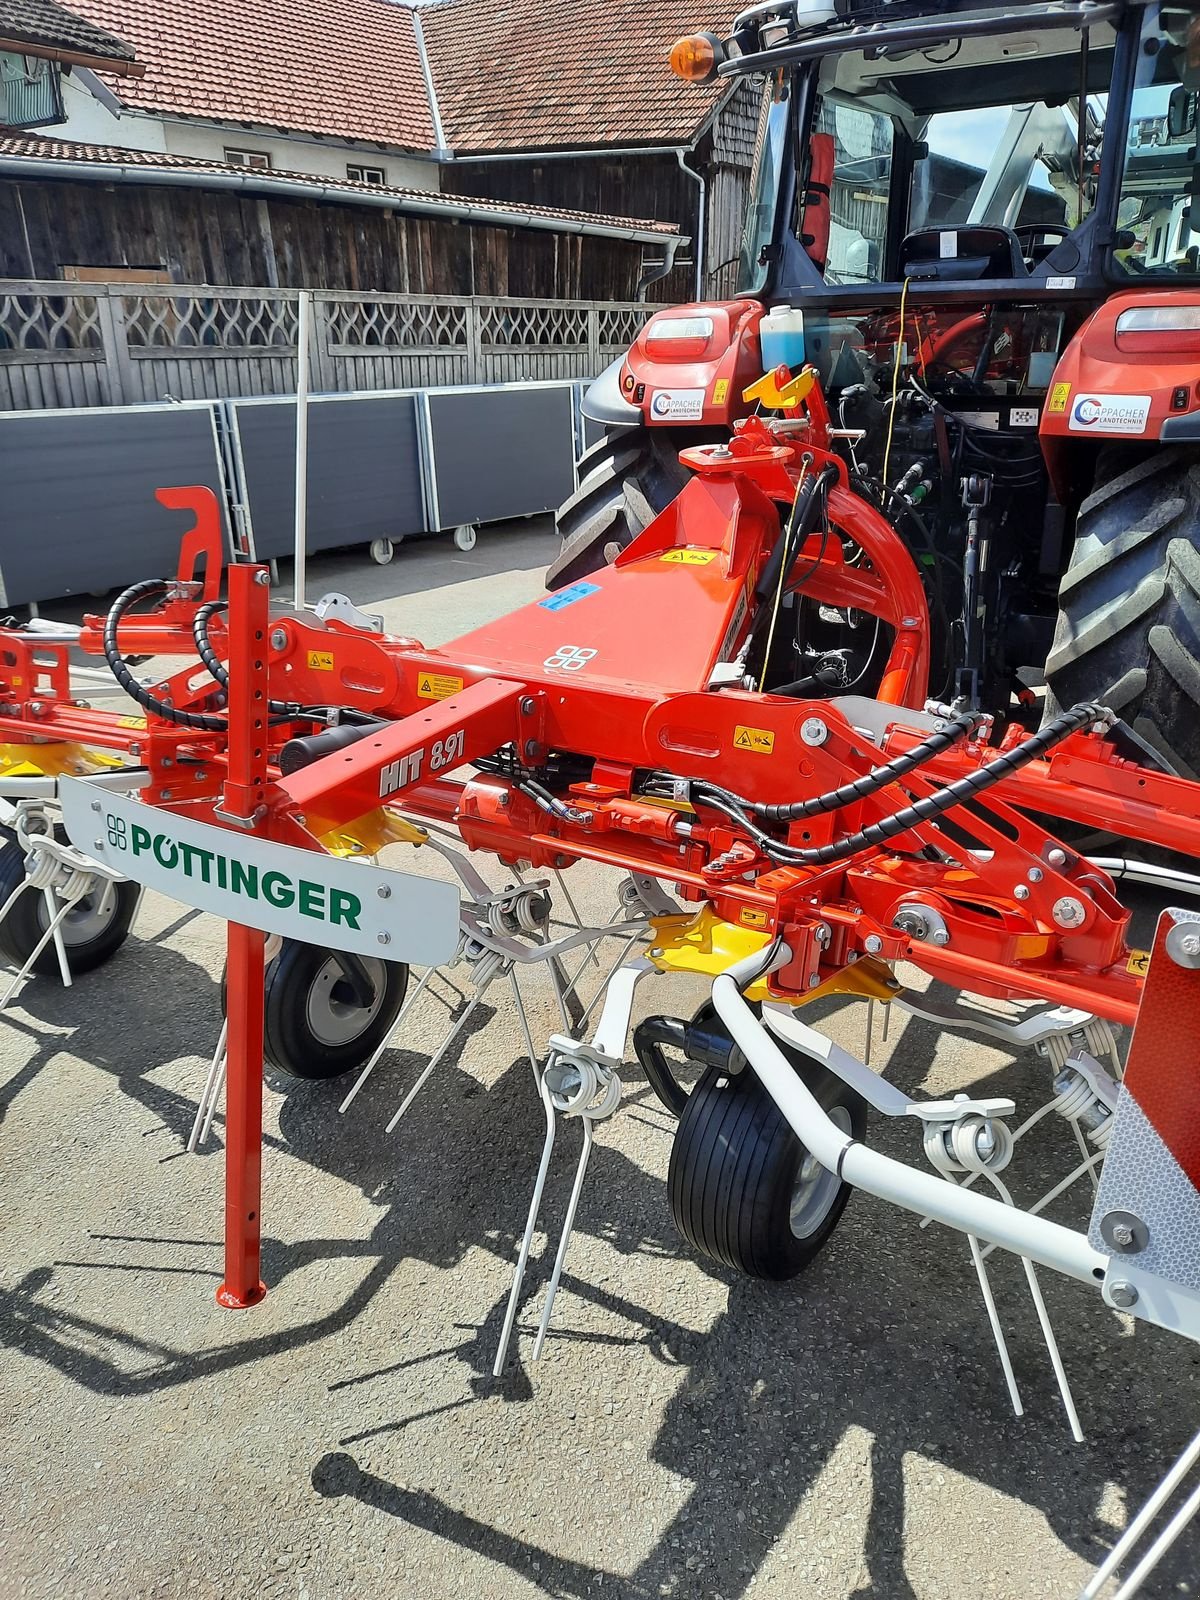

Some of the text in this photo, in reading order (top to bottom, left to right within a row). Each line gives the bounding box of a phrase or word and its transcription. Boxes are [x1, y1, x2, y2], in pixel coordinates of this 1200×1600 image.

[658, 400, 702, 408] KLAPPACHER
[1082, 407, 1145, 419] KLAPPACHER
[1099, 416, 1143, 425] LANDTECHNIK
[380, 729, 465, 798] HIT 8.91
[130, 823, 362, 931] PÖTTINGER
